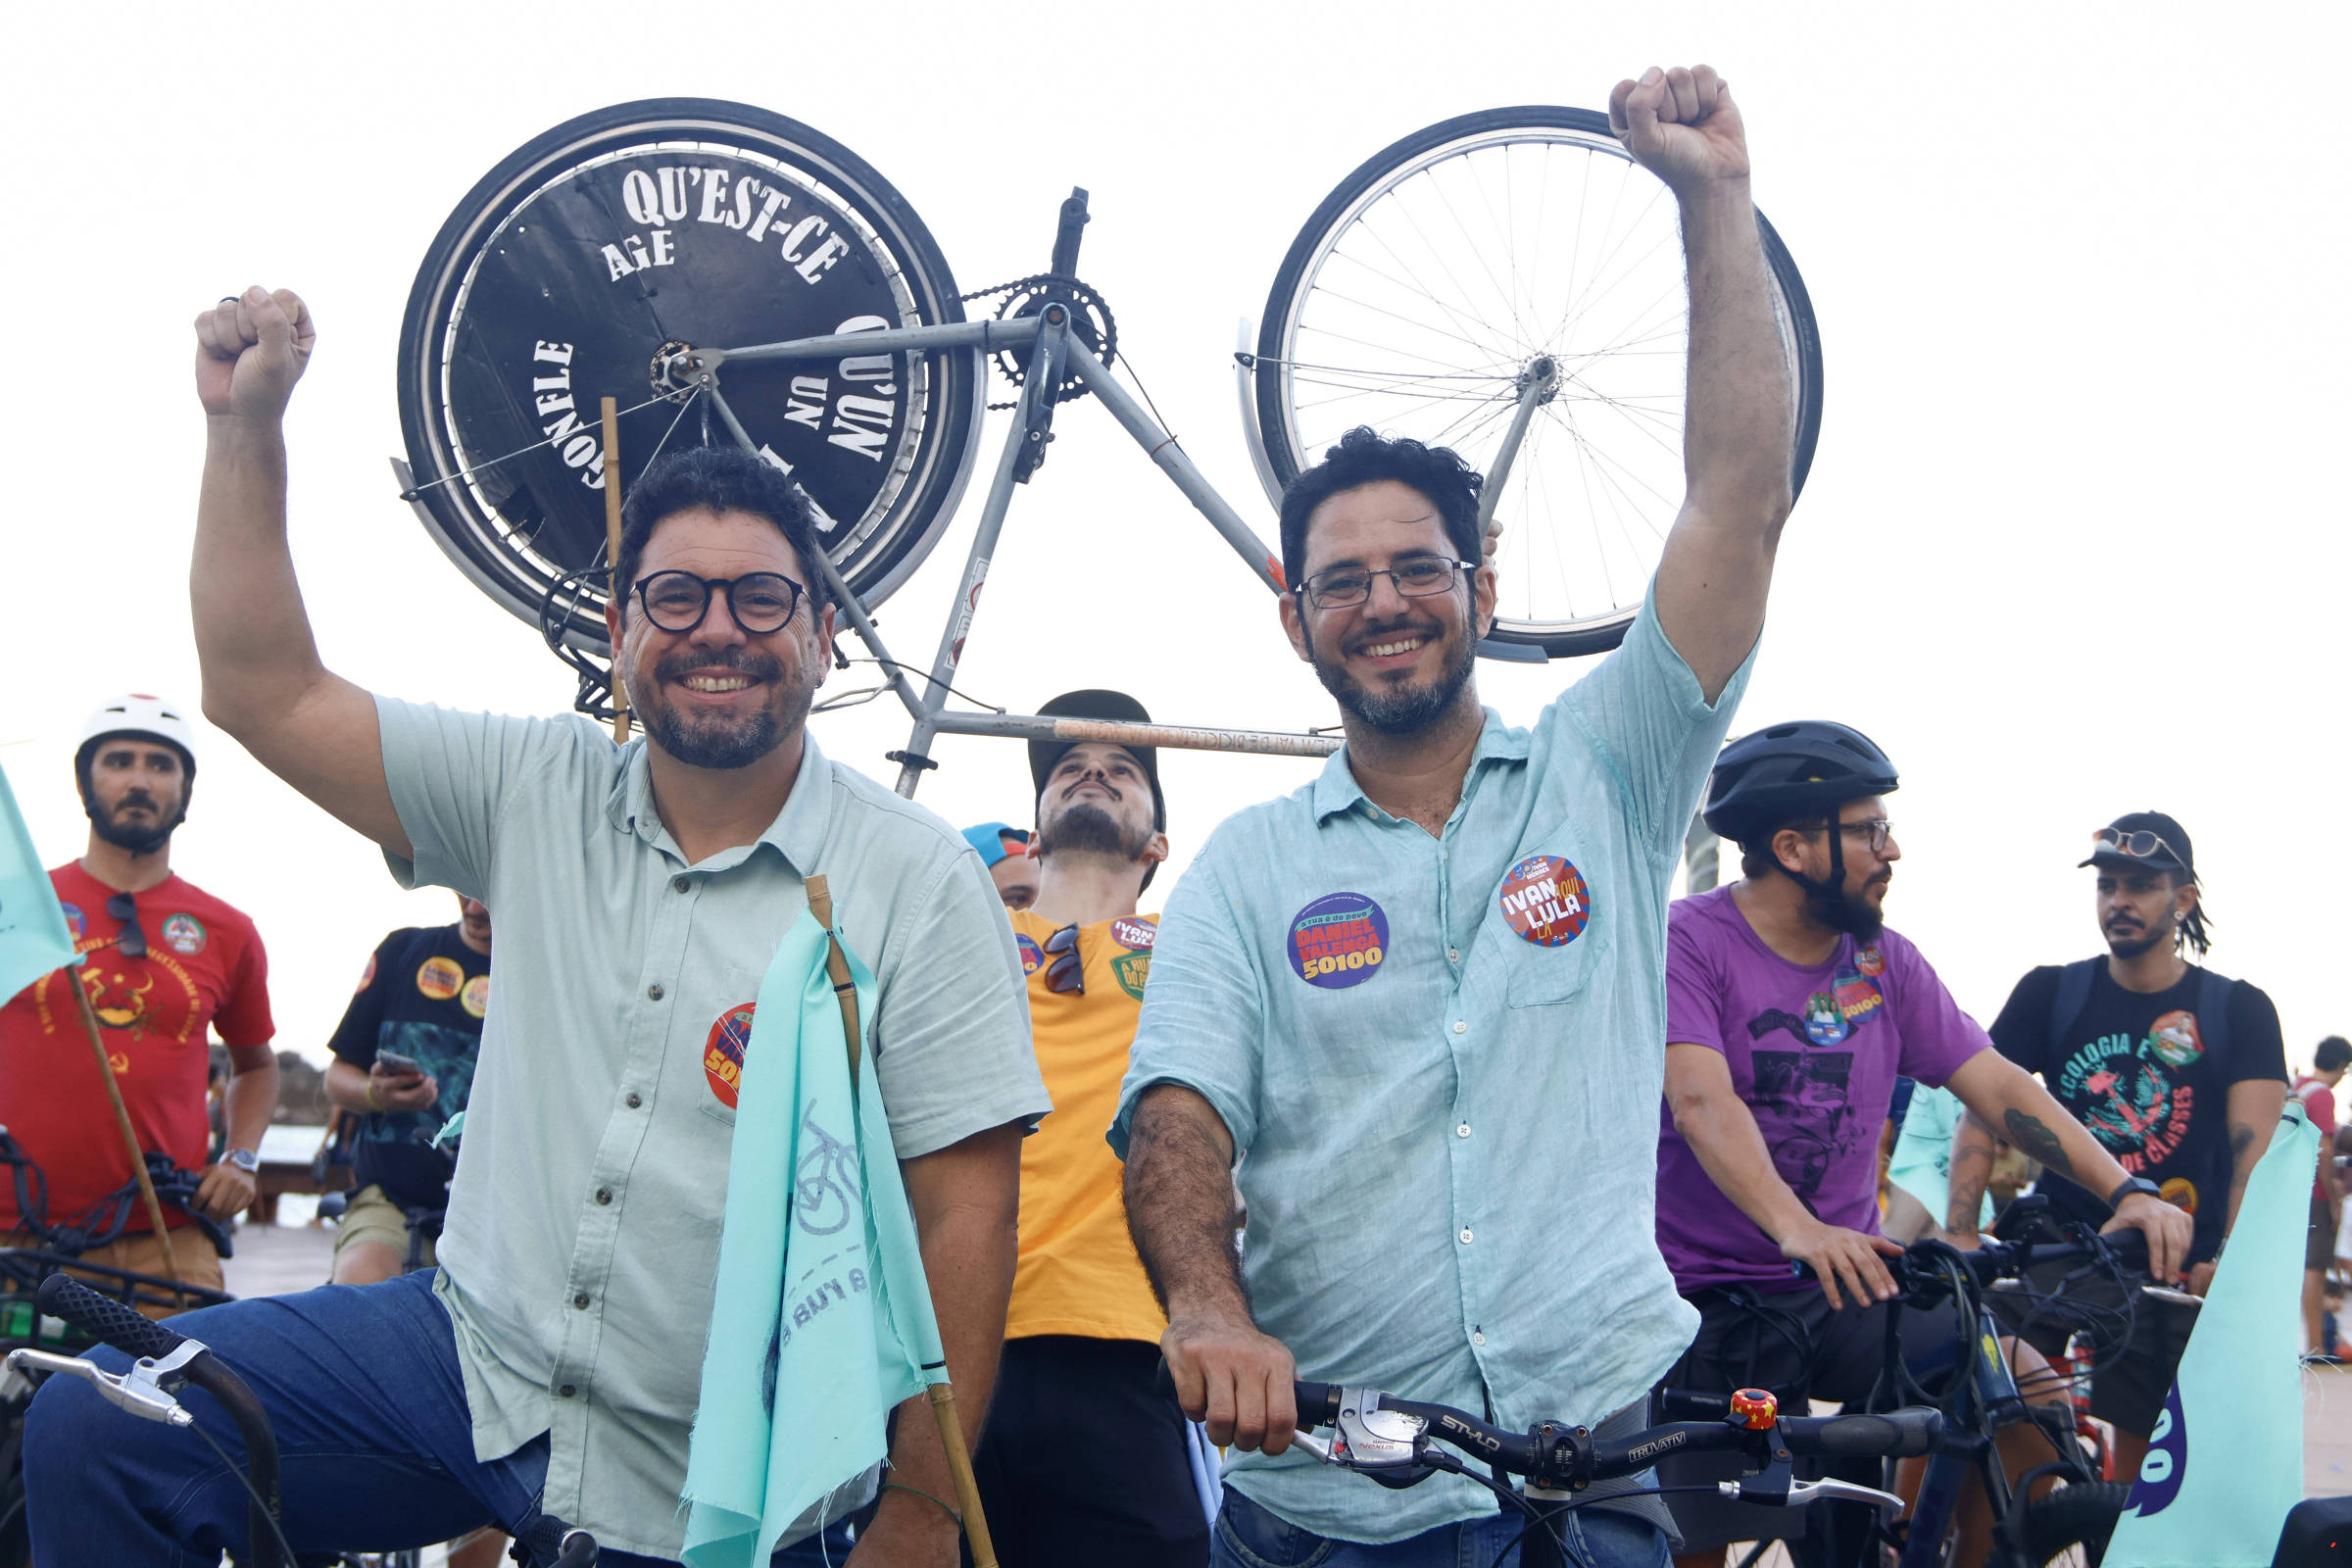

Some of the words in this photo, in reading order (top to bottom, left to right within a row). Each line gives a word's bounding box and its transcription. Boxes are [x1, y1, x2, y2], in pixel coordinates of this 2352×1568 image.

[622, 166, 851, 285] QU'EST-CE
[601, 229, 675, 283] AGE
[783, 374, 830, 431] UN
[1502, 877, 1557, 915] IVAN
[1554, 876, 1581, 901] AQUI
[1524, 893, 1582, 929] LULA
[1115, 920, 1153, 940] IVAN
[1120, 932, 1154, 947] LUL
[1295, 917, 1376, 949] DANIEL
[1298, 932, 1381, 962] VALENÇA
[1302, 947, 1383, 980] 50100
[2059, 1032, 2132, 1100] ECOLOGIA
[2143, 1085, 2194, 1164] CLASSES
[1440, 1413, 1500, 1451] STYLO
[1630, 1432, 1685, 1461] TRUVATIV
